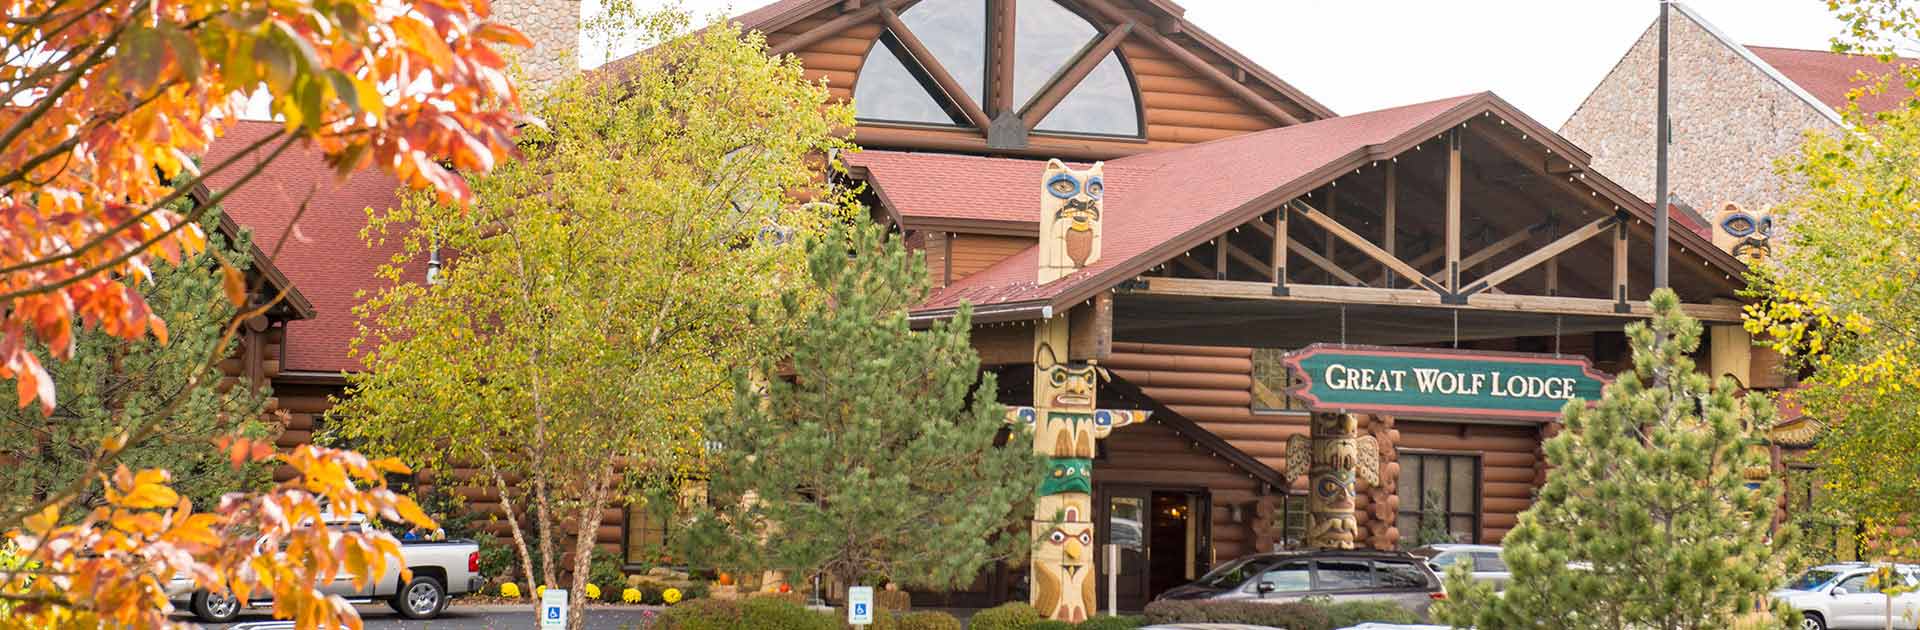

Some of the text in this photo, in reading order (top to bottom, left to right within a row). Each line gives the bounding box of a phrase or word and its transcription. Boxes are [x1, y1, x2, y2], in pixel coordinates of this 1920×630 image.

[1324, 363, 1576, 399] GREAT WOLF LODGE
